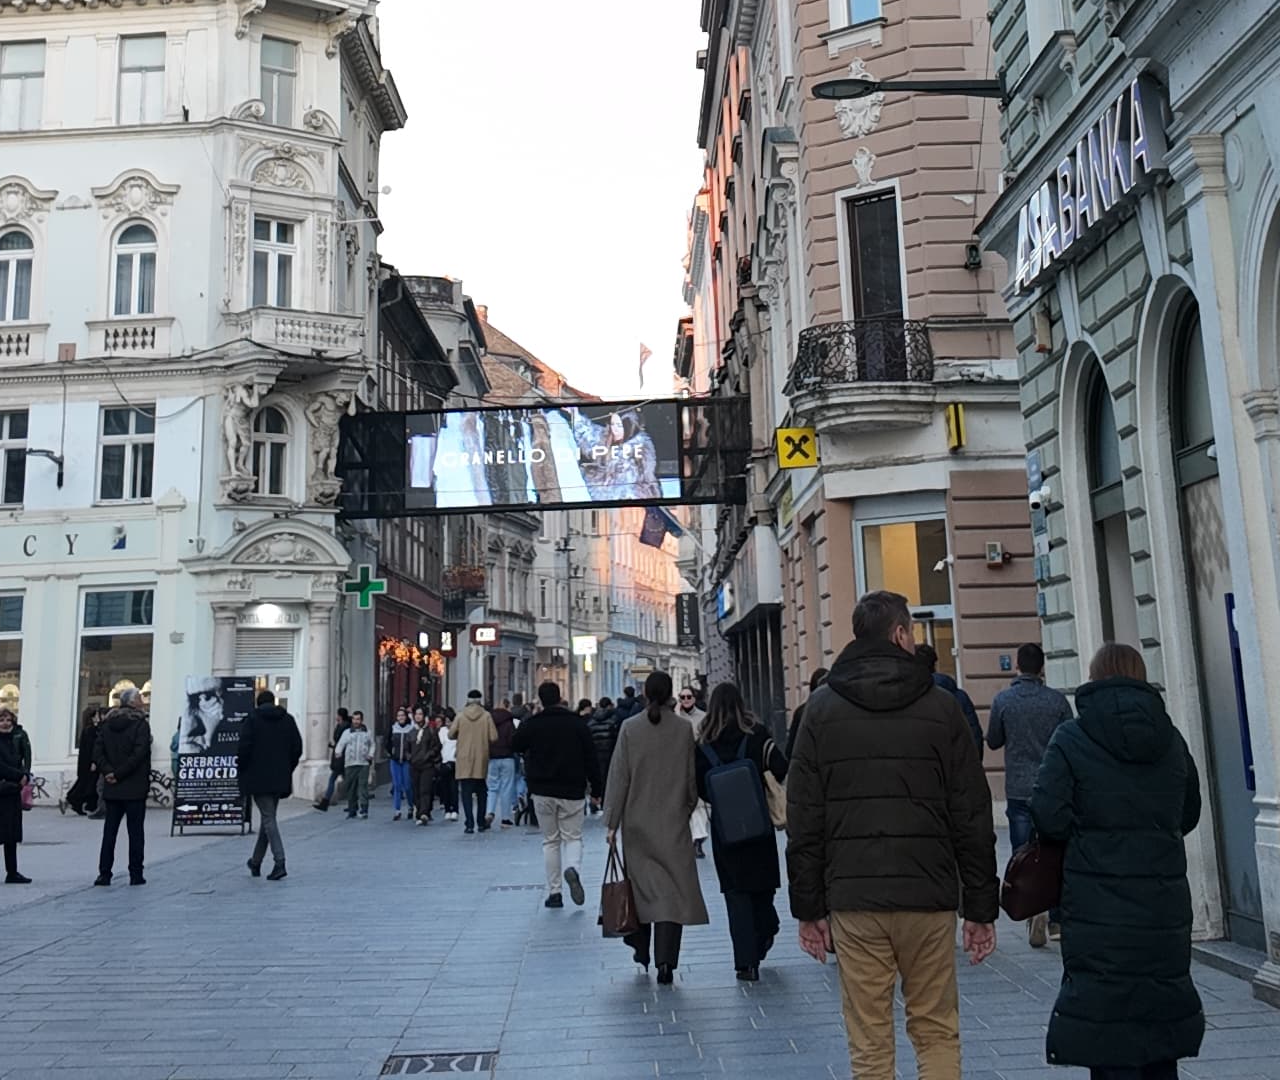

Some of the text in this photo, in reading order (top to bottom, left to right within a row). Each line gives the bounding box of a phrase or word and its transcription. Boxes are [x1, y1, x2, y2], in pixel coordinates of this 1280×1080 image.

[1057, 78, 1152, 249] BANKA
[592, 443, 643, 461] PEPE
[179, 756, 239, 768] SREBRENIC
[178, 767, 238, 779] GENOCID
